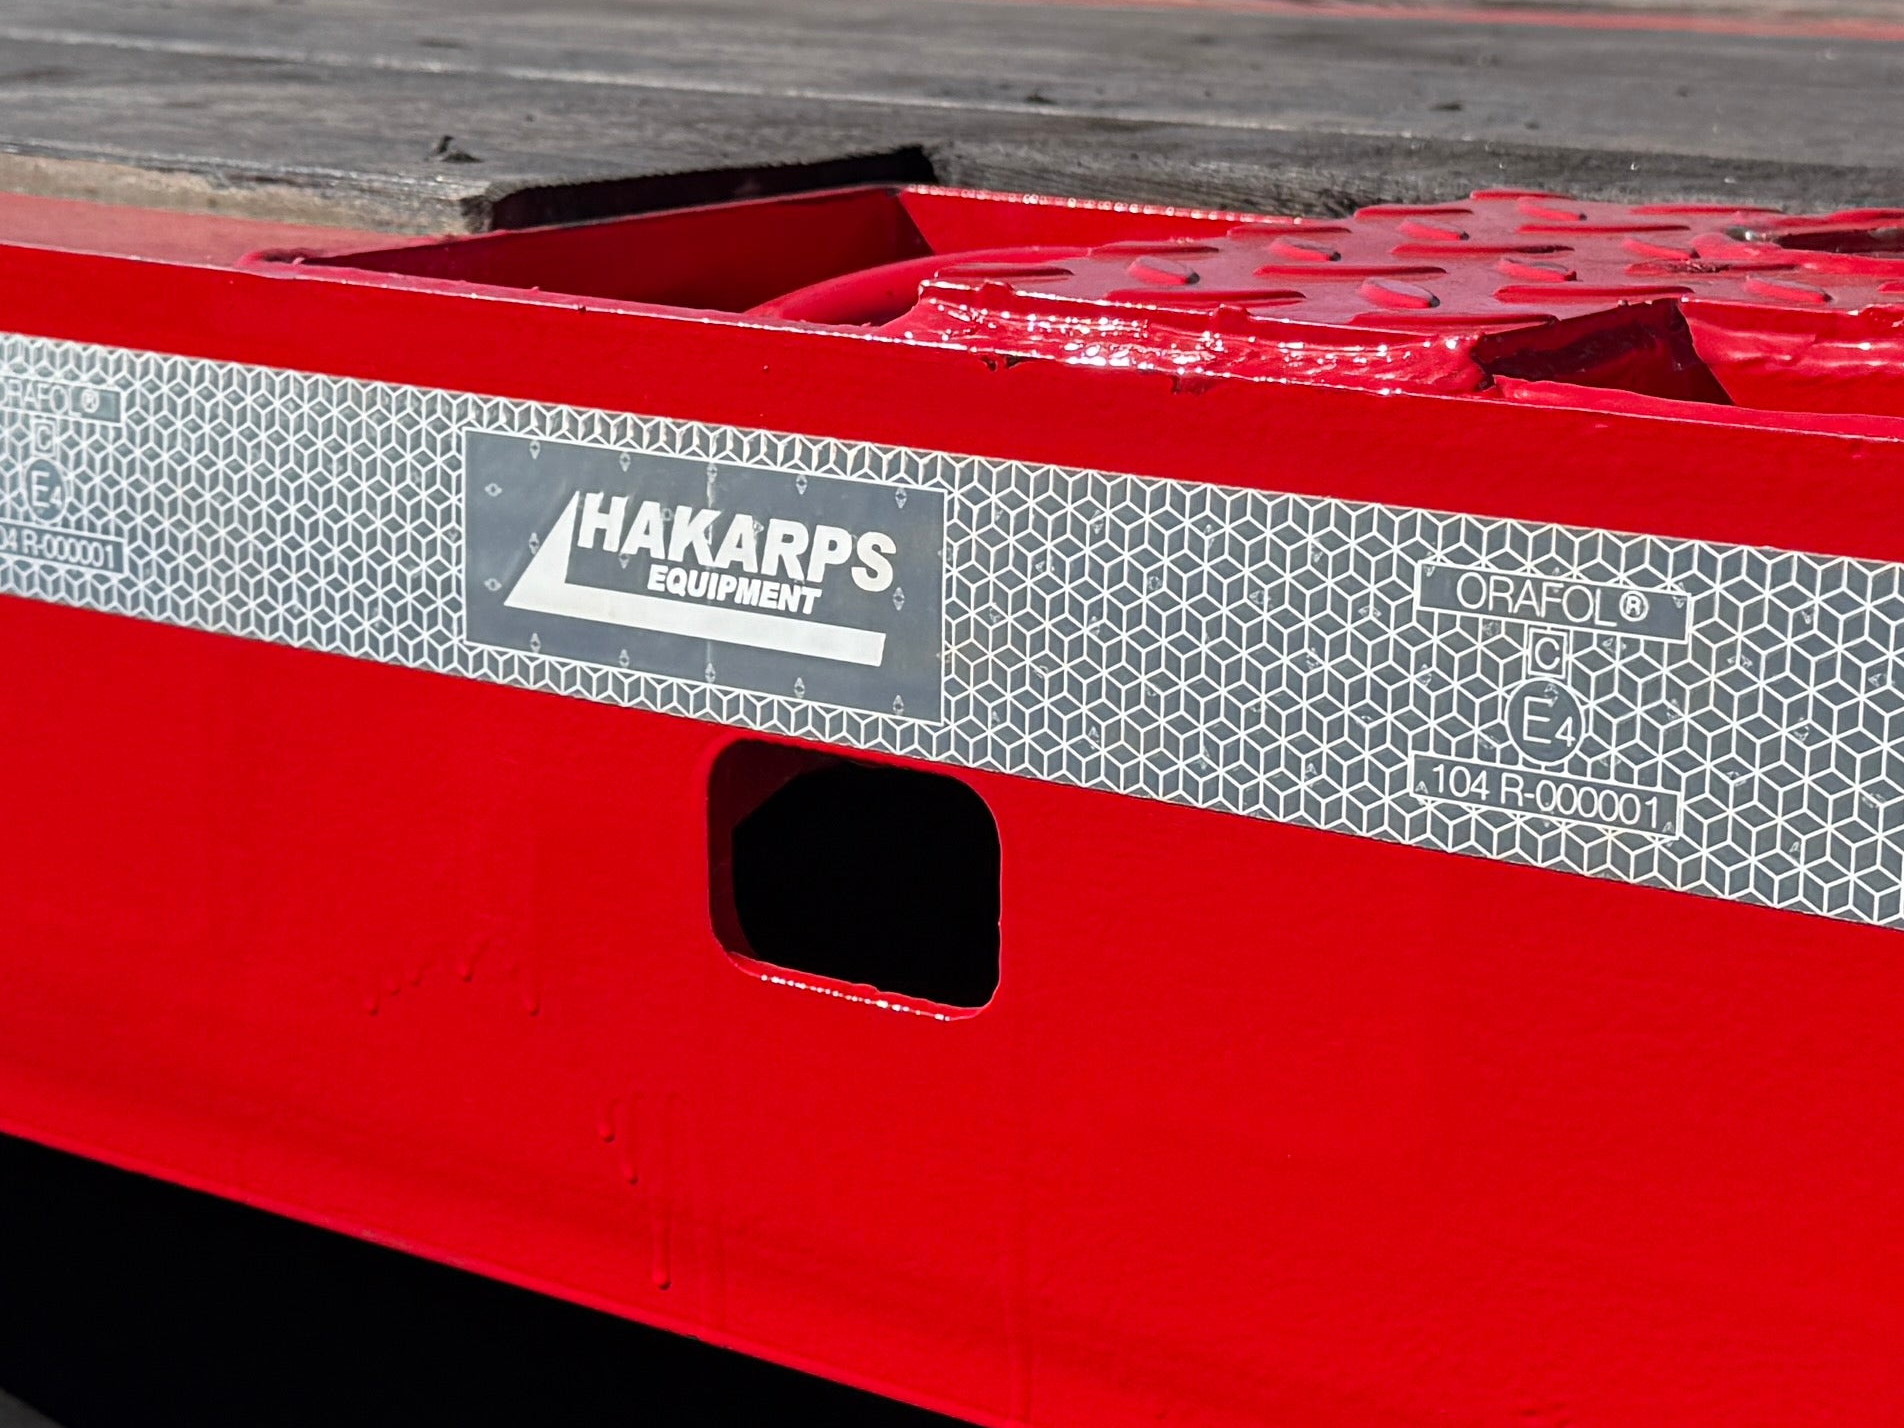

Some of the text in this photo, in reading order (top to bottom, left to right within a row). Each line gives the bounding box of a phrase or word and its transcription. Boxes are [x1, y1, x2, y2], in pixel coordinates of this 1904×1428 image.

[577, 492, 897, 592] HAKARPS
[647, 564, 822, 615] EQUIPMENT
[1534, 636, 1561, 670] C
[1432, 763, 1659, 829] 104 R-00001
